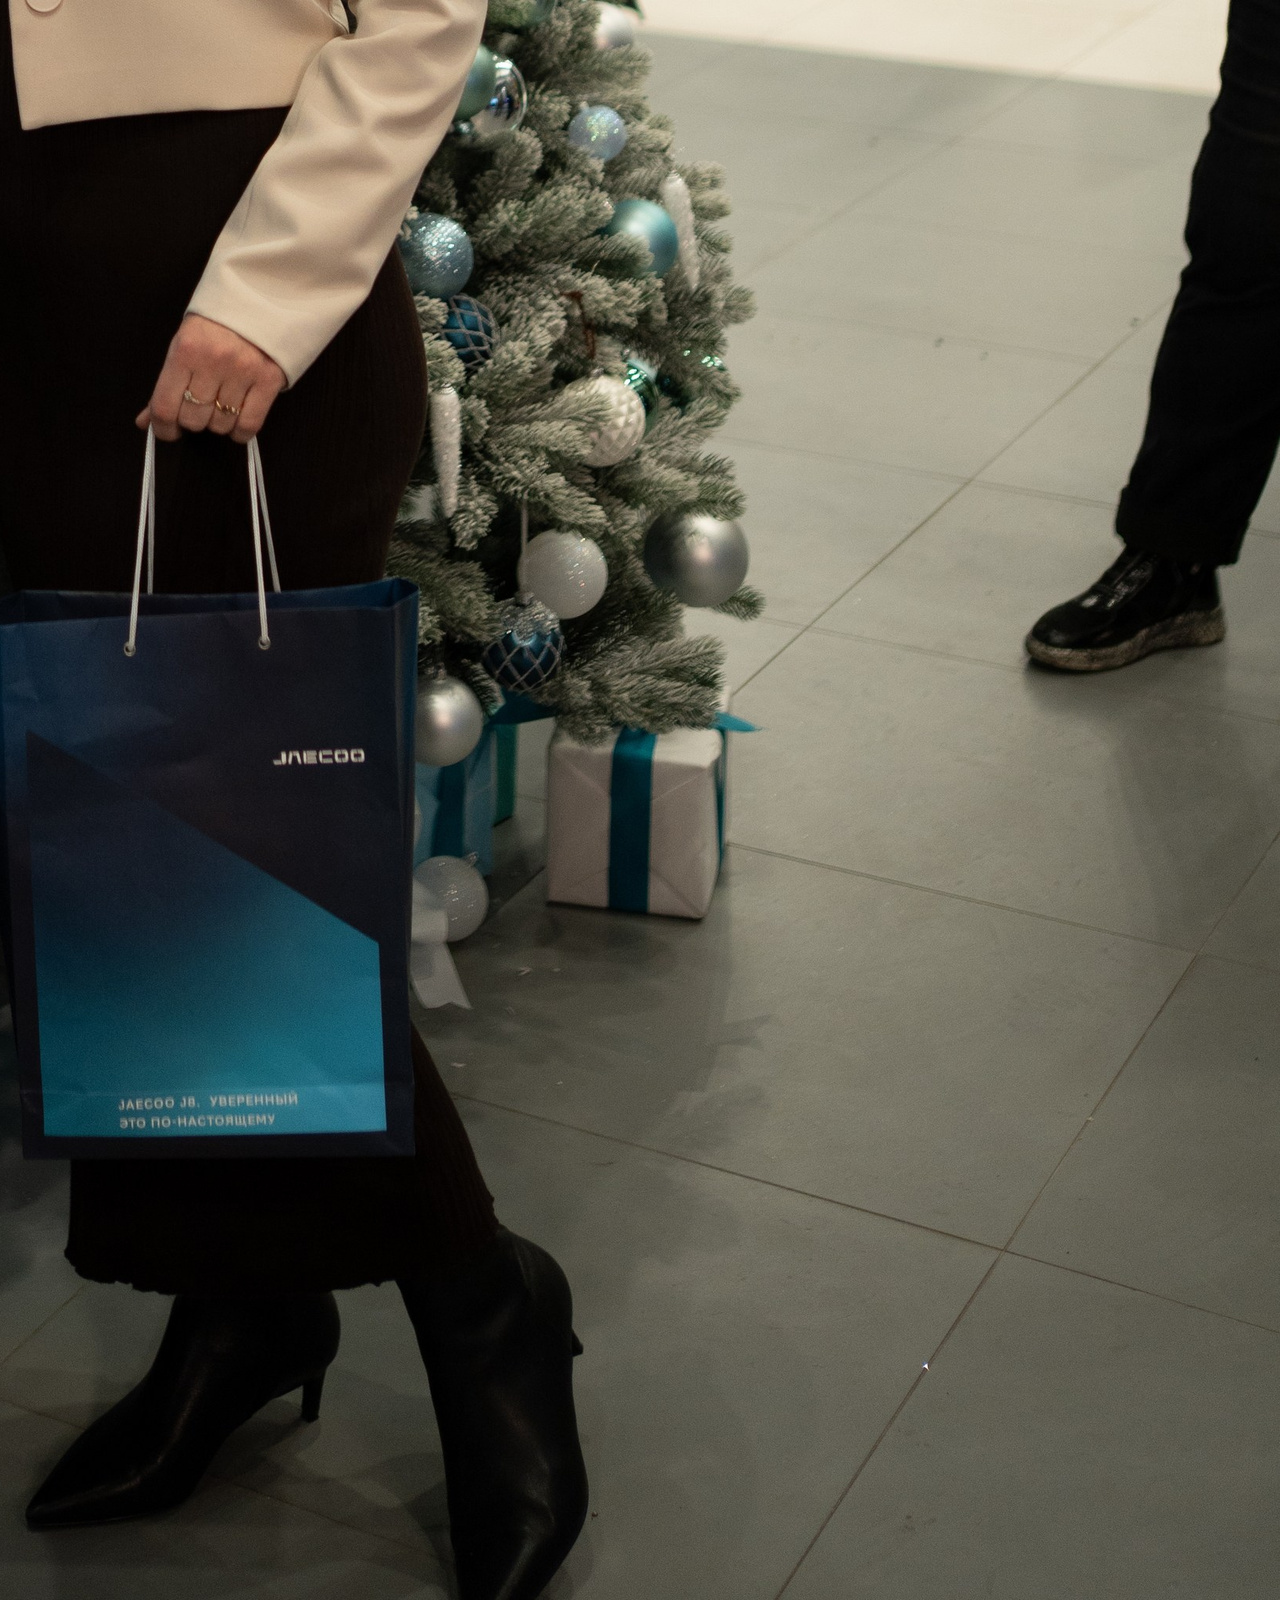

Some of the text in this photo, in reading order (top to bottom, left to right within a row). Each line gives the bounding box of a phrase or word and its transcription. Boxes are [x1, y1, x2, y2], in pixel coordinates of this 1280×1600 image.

[273, 748, 365, 766] JAECOO
[118, 1097, 175, 1111] JAECOO
[209, 1090, 299, 1108] УВЕРЕННЫЙ
[119, 1113, 275, 1129] ЭТО ПО-НАСТОЯЩЕМУ
